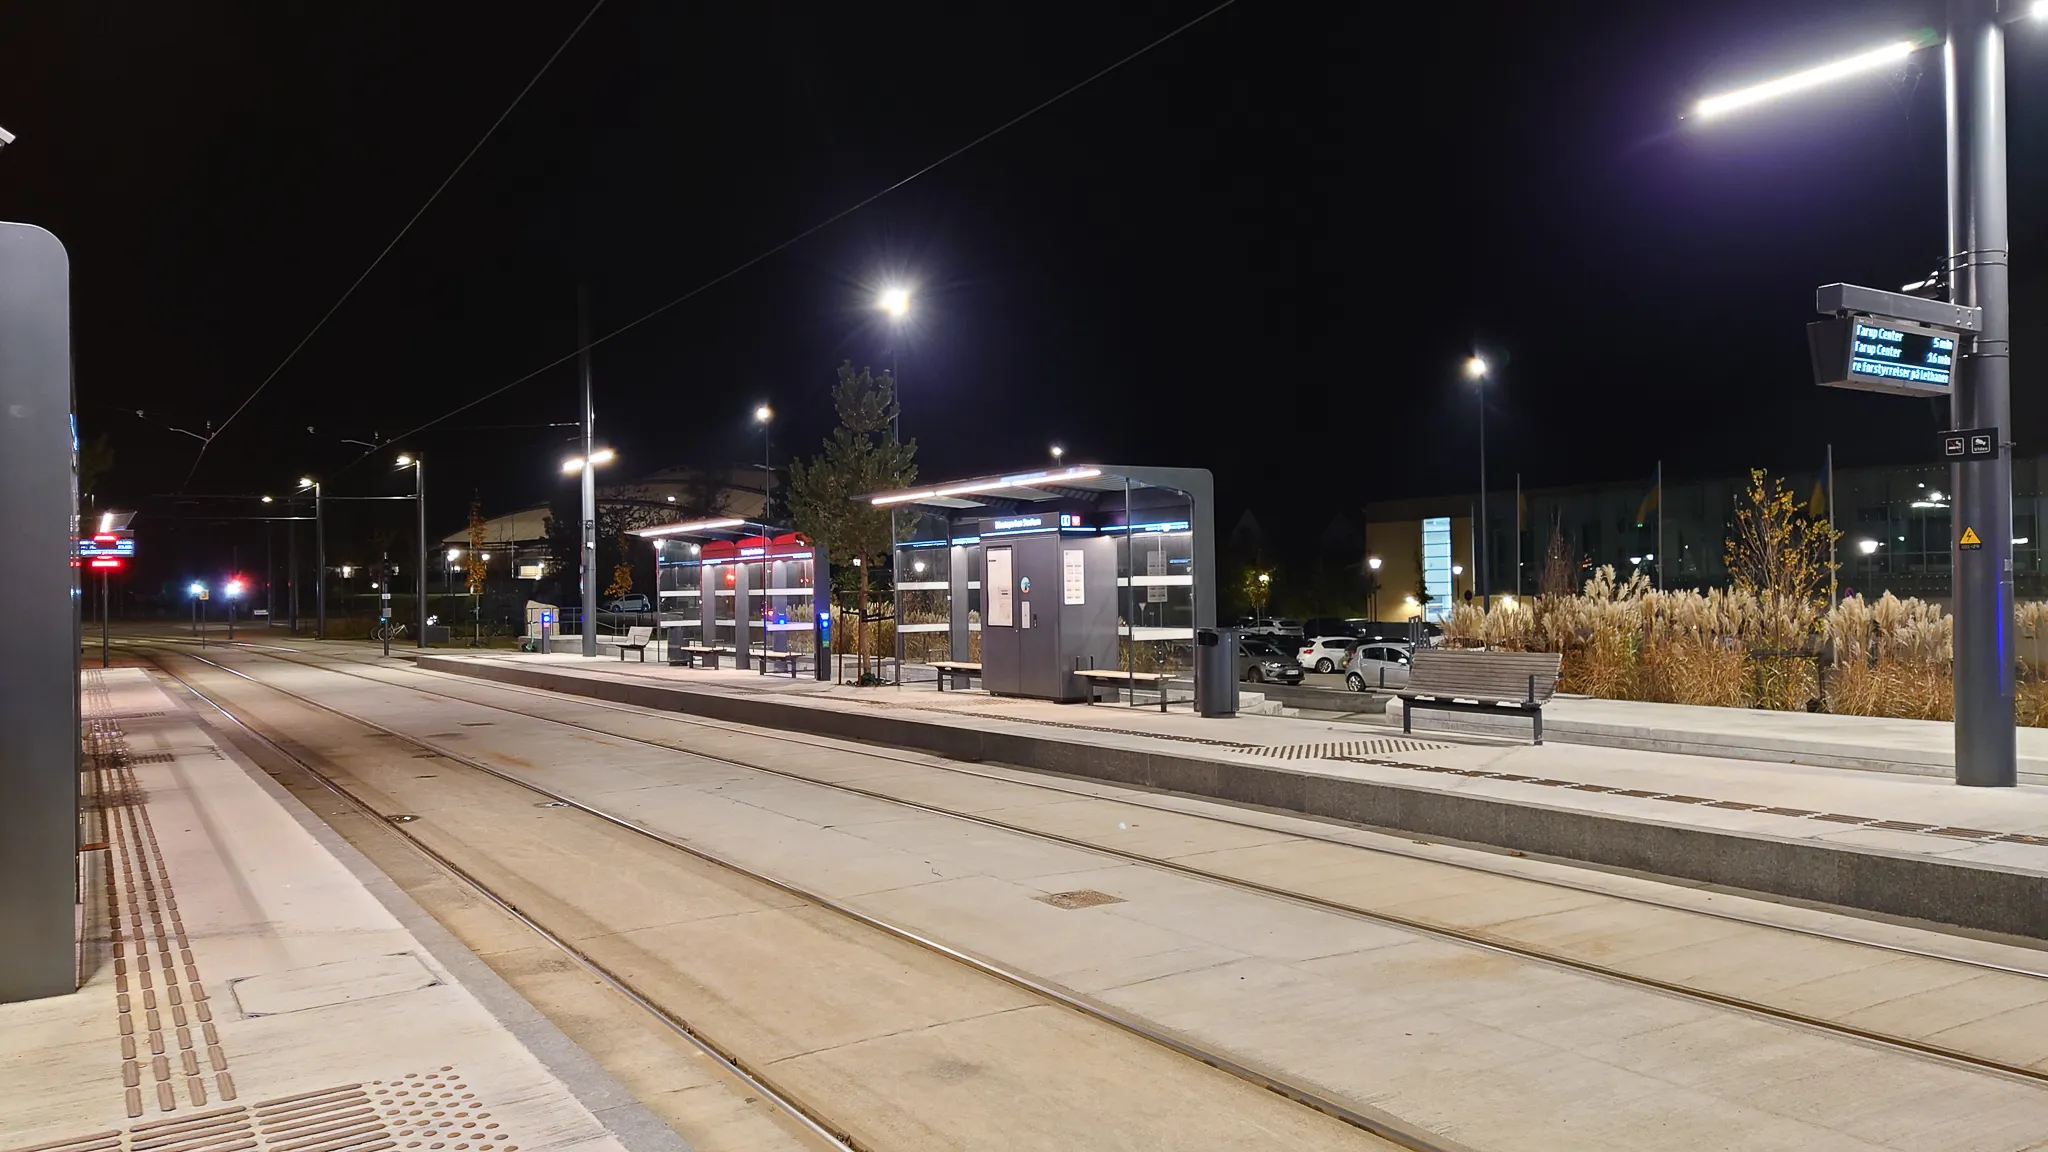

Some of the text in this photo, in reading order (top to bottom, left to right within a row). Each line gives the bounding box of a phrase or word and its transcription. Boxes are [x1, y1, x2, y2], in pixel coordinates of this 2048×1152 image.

[1857, 325, 1953, 350] Tarup Center 5 min
[1855, 341, 1951, 365] Tarup Center 16 min
